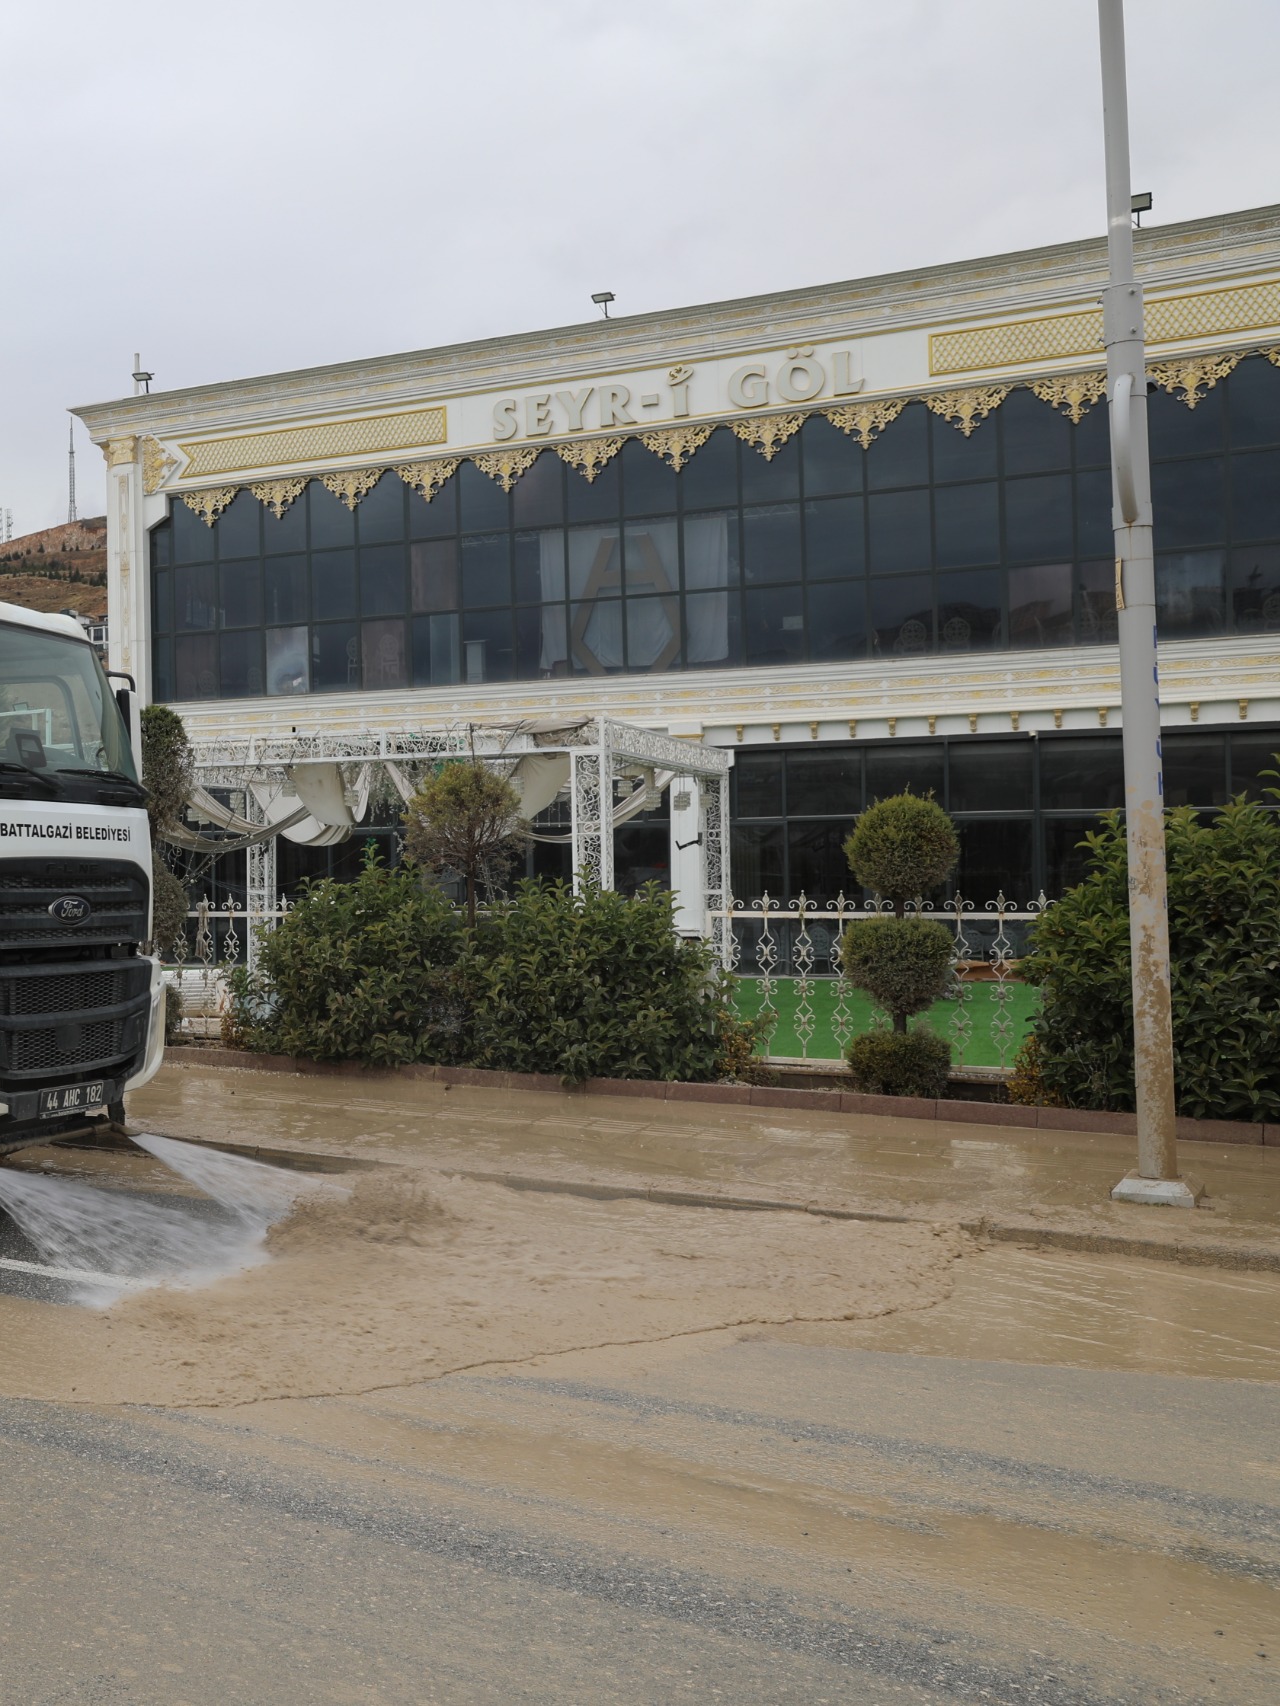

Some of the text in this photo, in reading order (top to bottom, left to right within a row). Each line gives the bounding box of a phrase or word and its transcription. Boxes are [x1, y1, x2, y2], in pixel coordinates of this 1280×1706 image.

[492, 345, 864, 441] SEYR-İ GÖL
[0, 822, 131, 841] BATTALGAZİ BELEDİYESİ
[61, 900, 84, 917] Ford
[46, 1085, 102, 1110] 44 AHC 182
